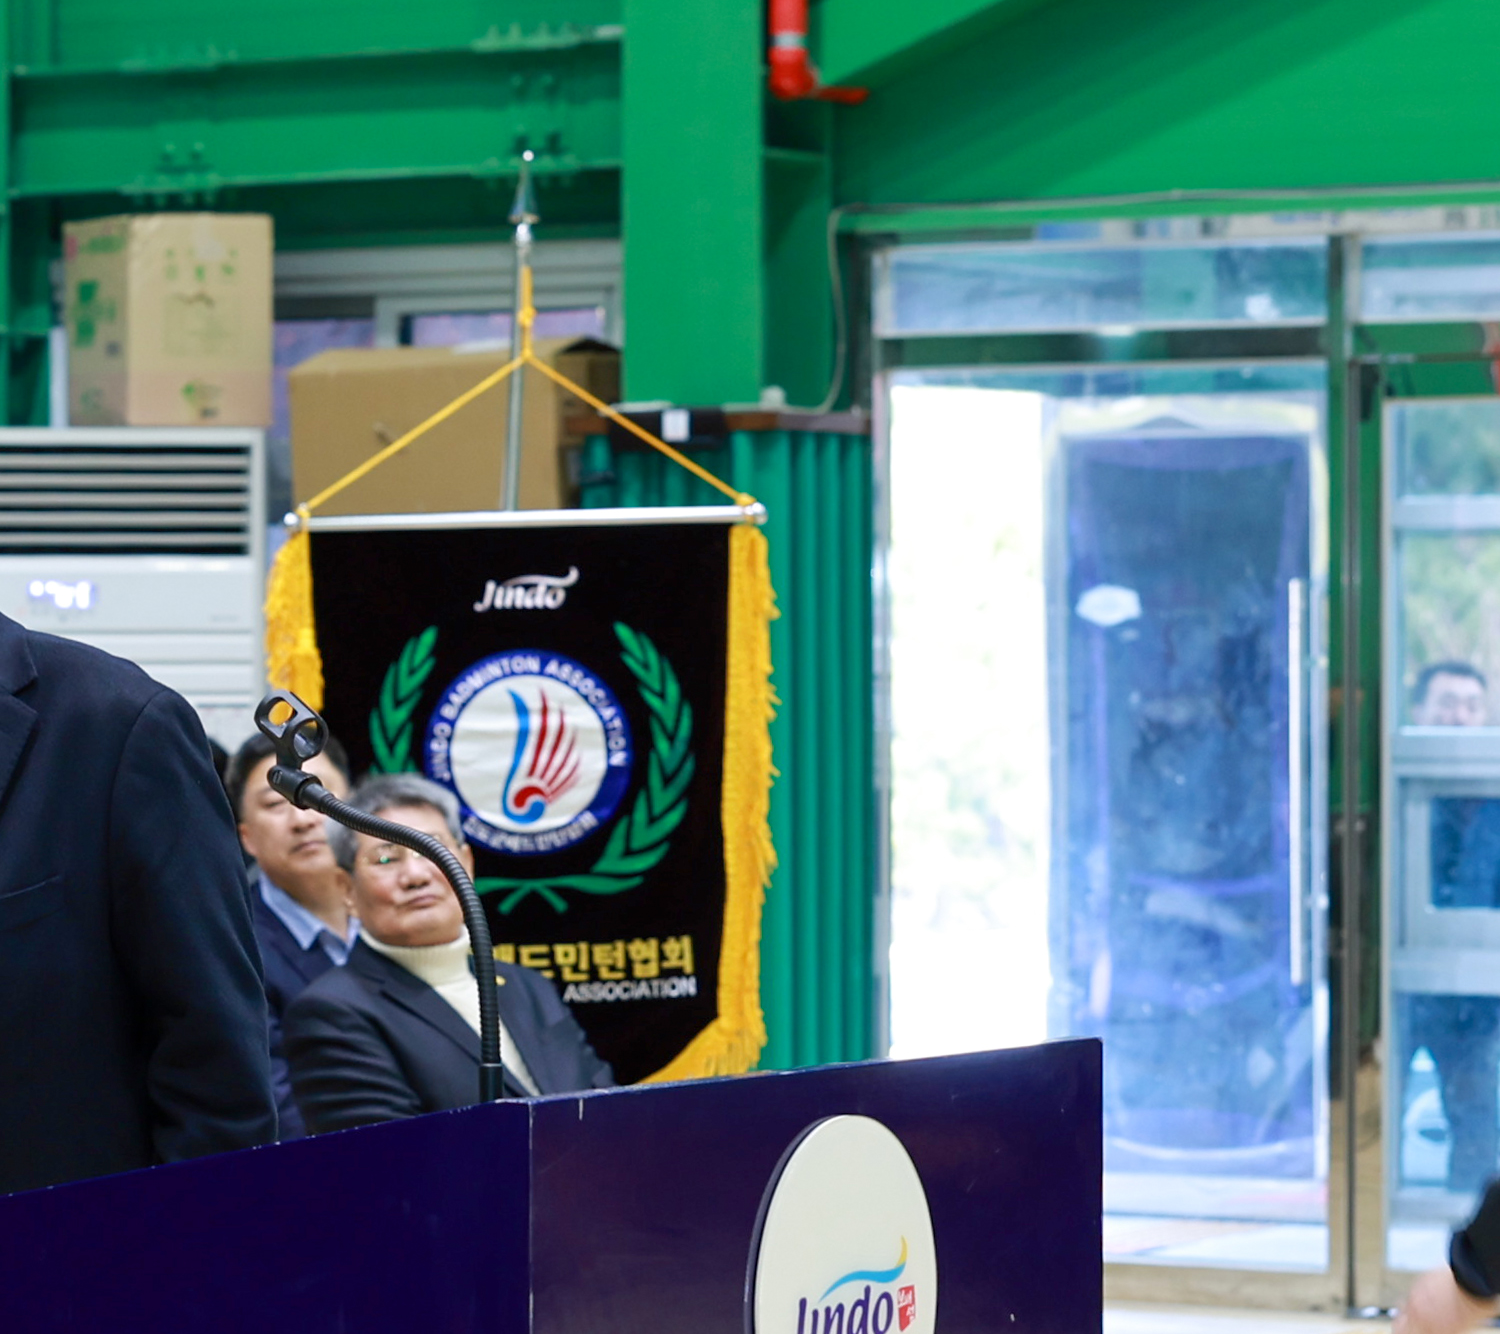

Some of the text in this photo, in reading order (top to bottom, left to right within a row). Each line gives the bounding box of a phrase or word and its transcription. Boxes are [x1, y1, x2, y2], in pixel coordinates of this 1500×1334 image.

[473, 573, 570, 613] Jindo
[440, 655, 541, 720] BADMINTON
[543, 659, 629, 767] ASSOCIATION
[563, 975, 698, 1003] ASSOCIATION
